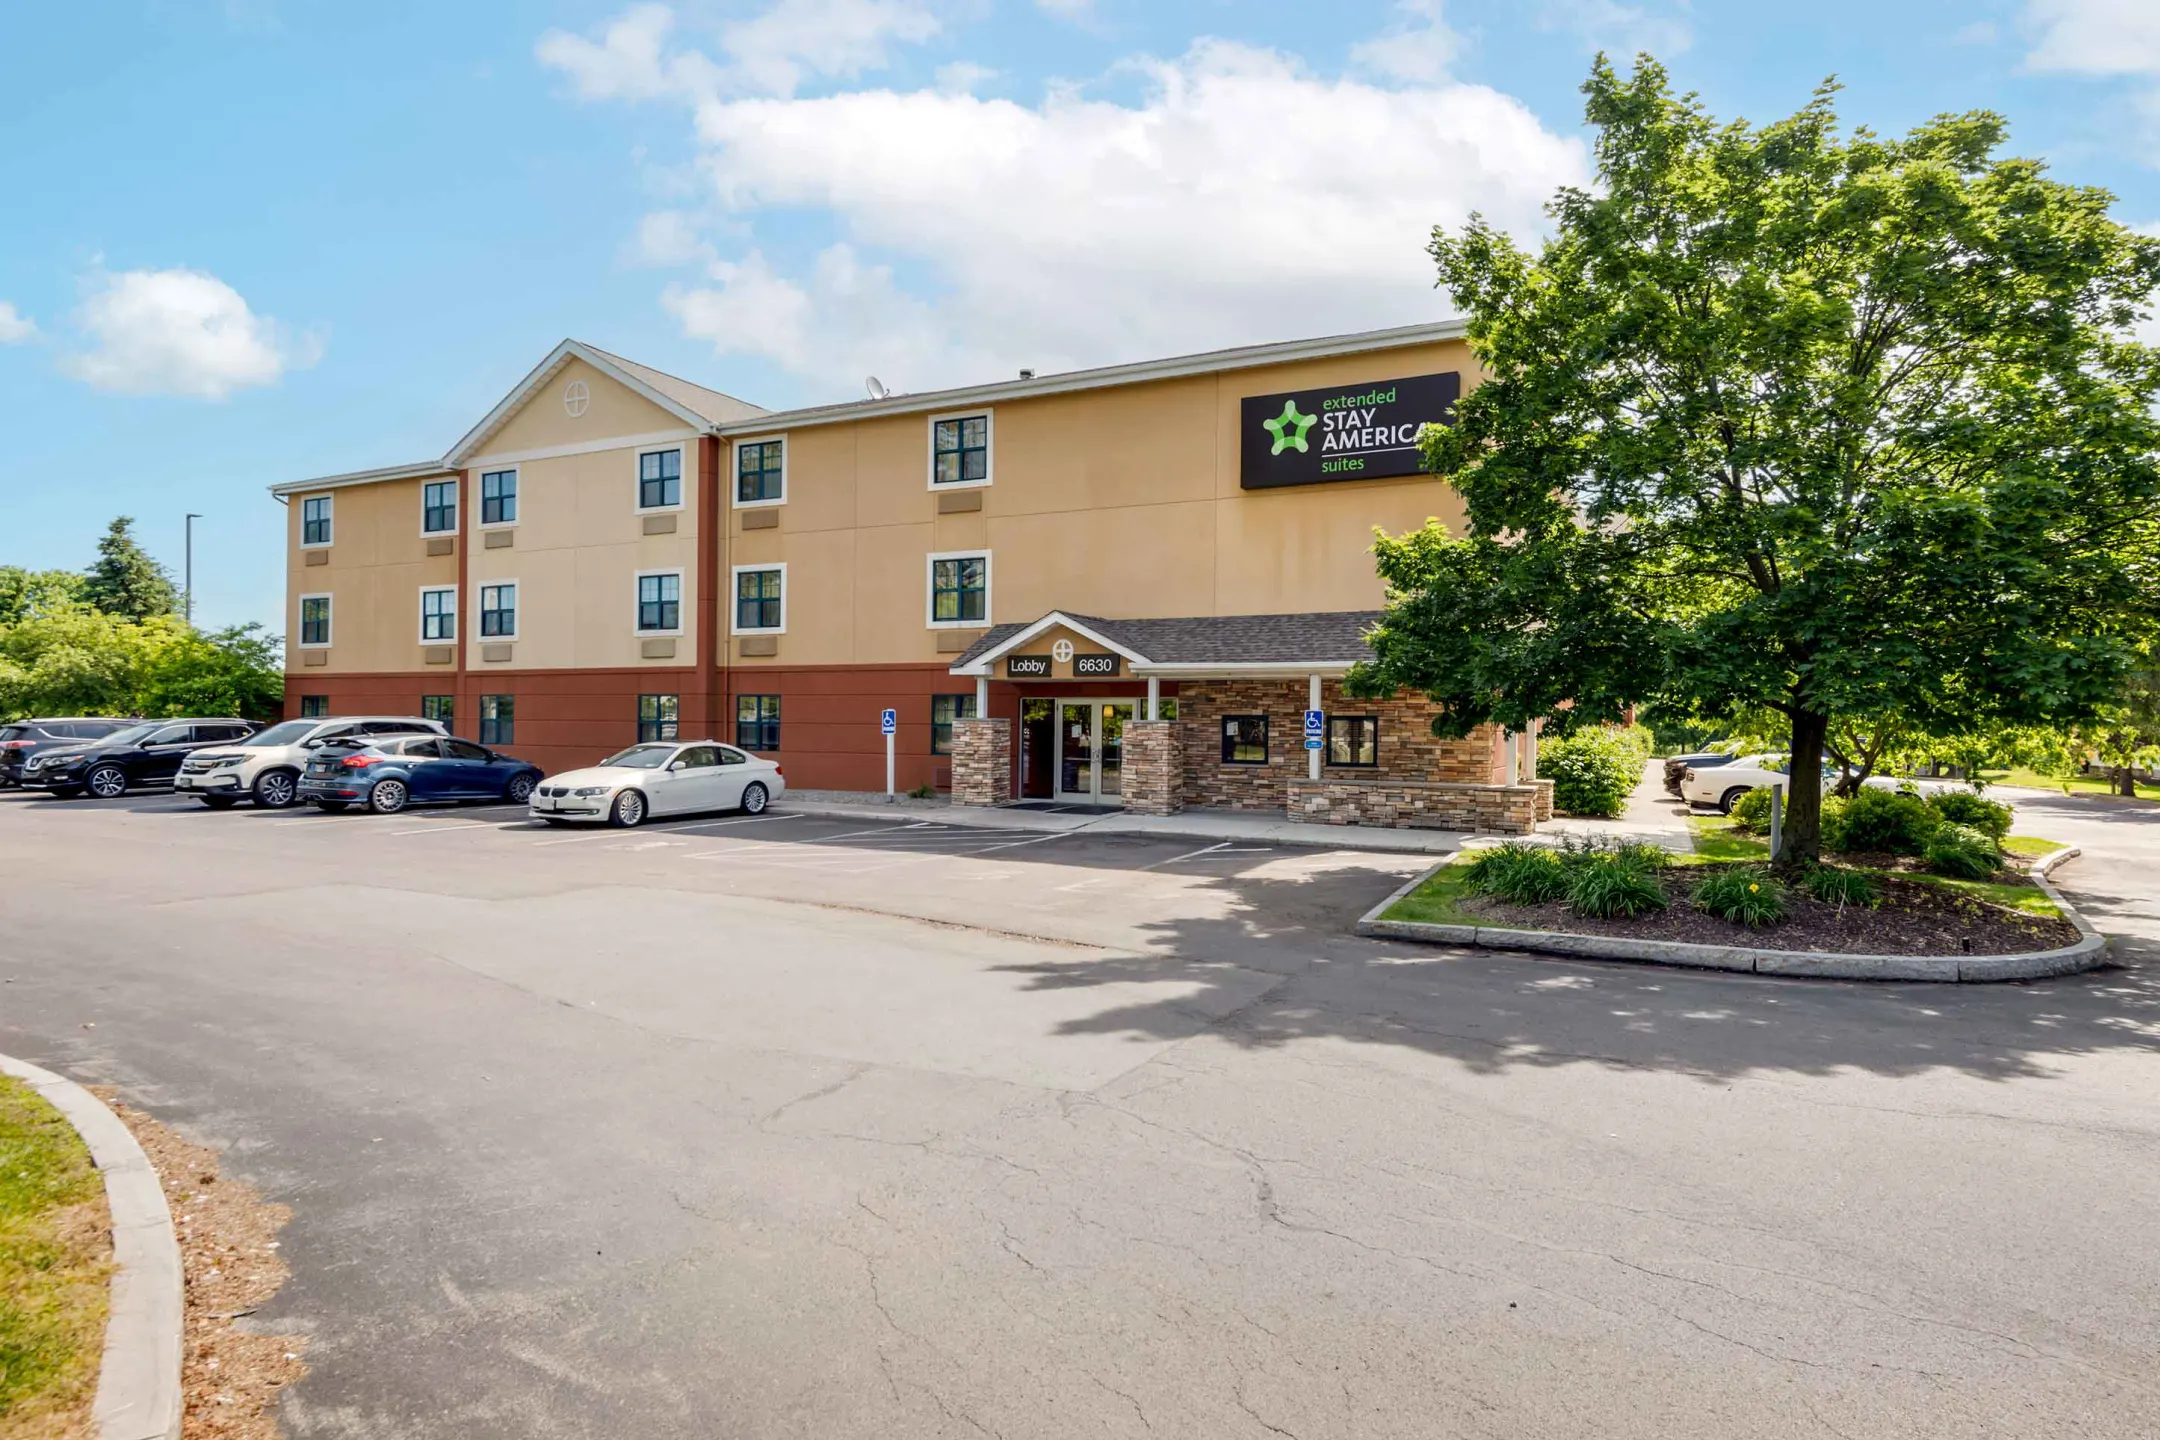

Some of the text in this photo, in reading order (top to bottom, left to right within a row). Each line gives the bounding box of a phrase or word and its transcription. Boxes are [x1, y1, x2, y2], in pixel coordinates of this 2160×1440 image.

[1323, 387, 1396, 410] extended
[1323, 407, 1376, 431] STAY
[1322, 458, 1364, 473] suites
[1011, 659, 1046, 674] Lobby
[1079, 658, 1112, 671] 6630
